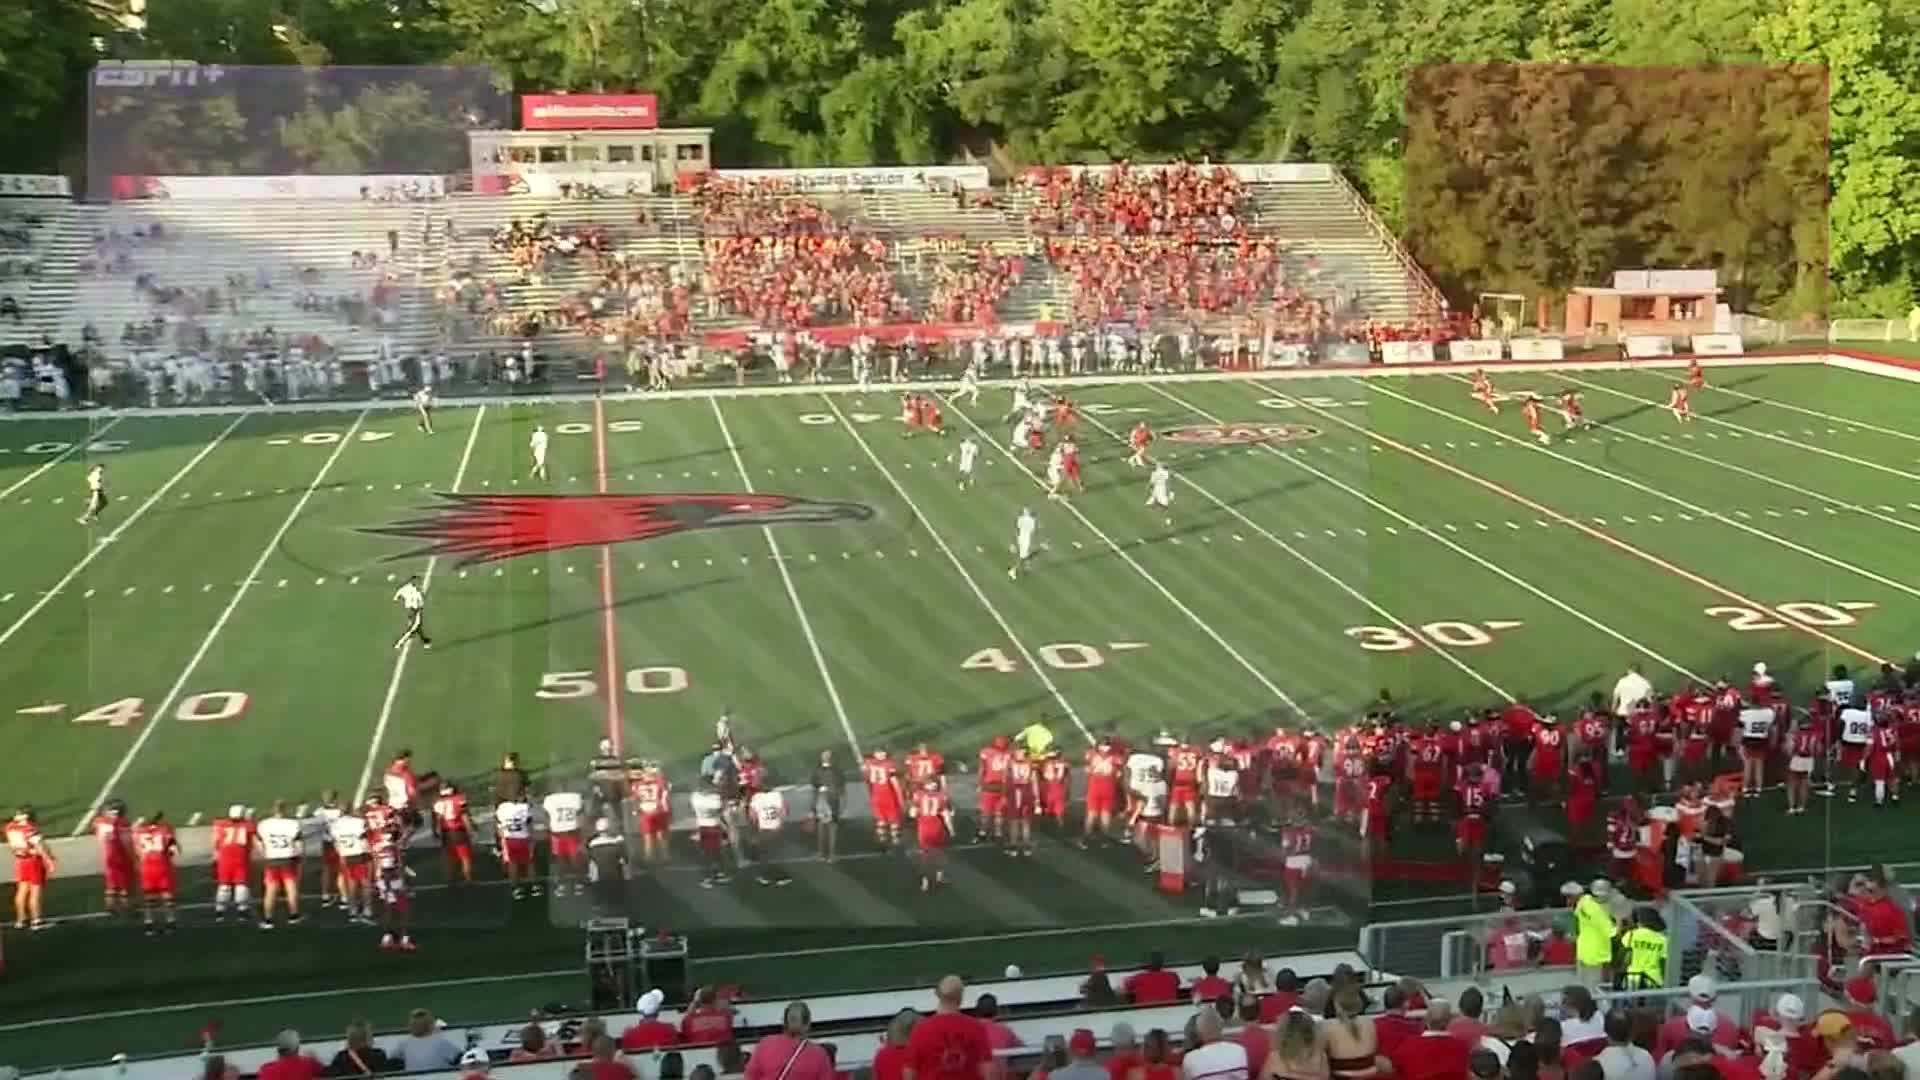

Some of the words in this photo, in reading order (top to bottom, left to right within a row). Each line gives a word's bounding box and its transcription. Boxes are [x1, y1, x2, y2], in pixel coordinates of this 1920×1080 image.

[1703, 601, 1858, 633] 20
[1343, 620, 1495, 652] 30
[961, 642, 1106, 673] 40
[535, 665, 690, 699] 50
[72, 690, 250, 727] 40
[1466, 787, 1484, 807] 15
